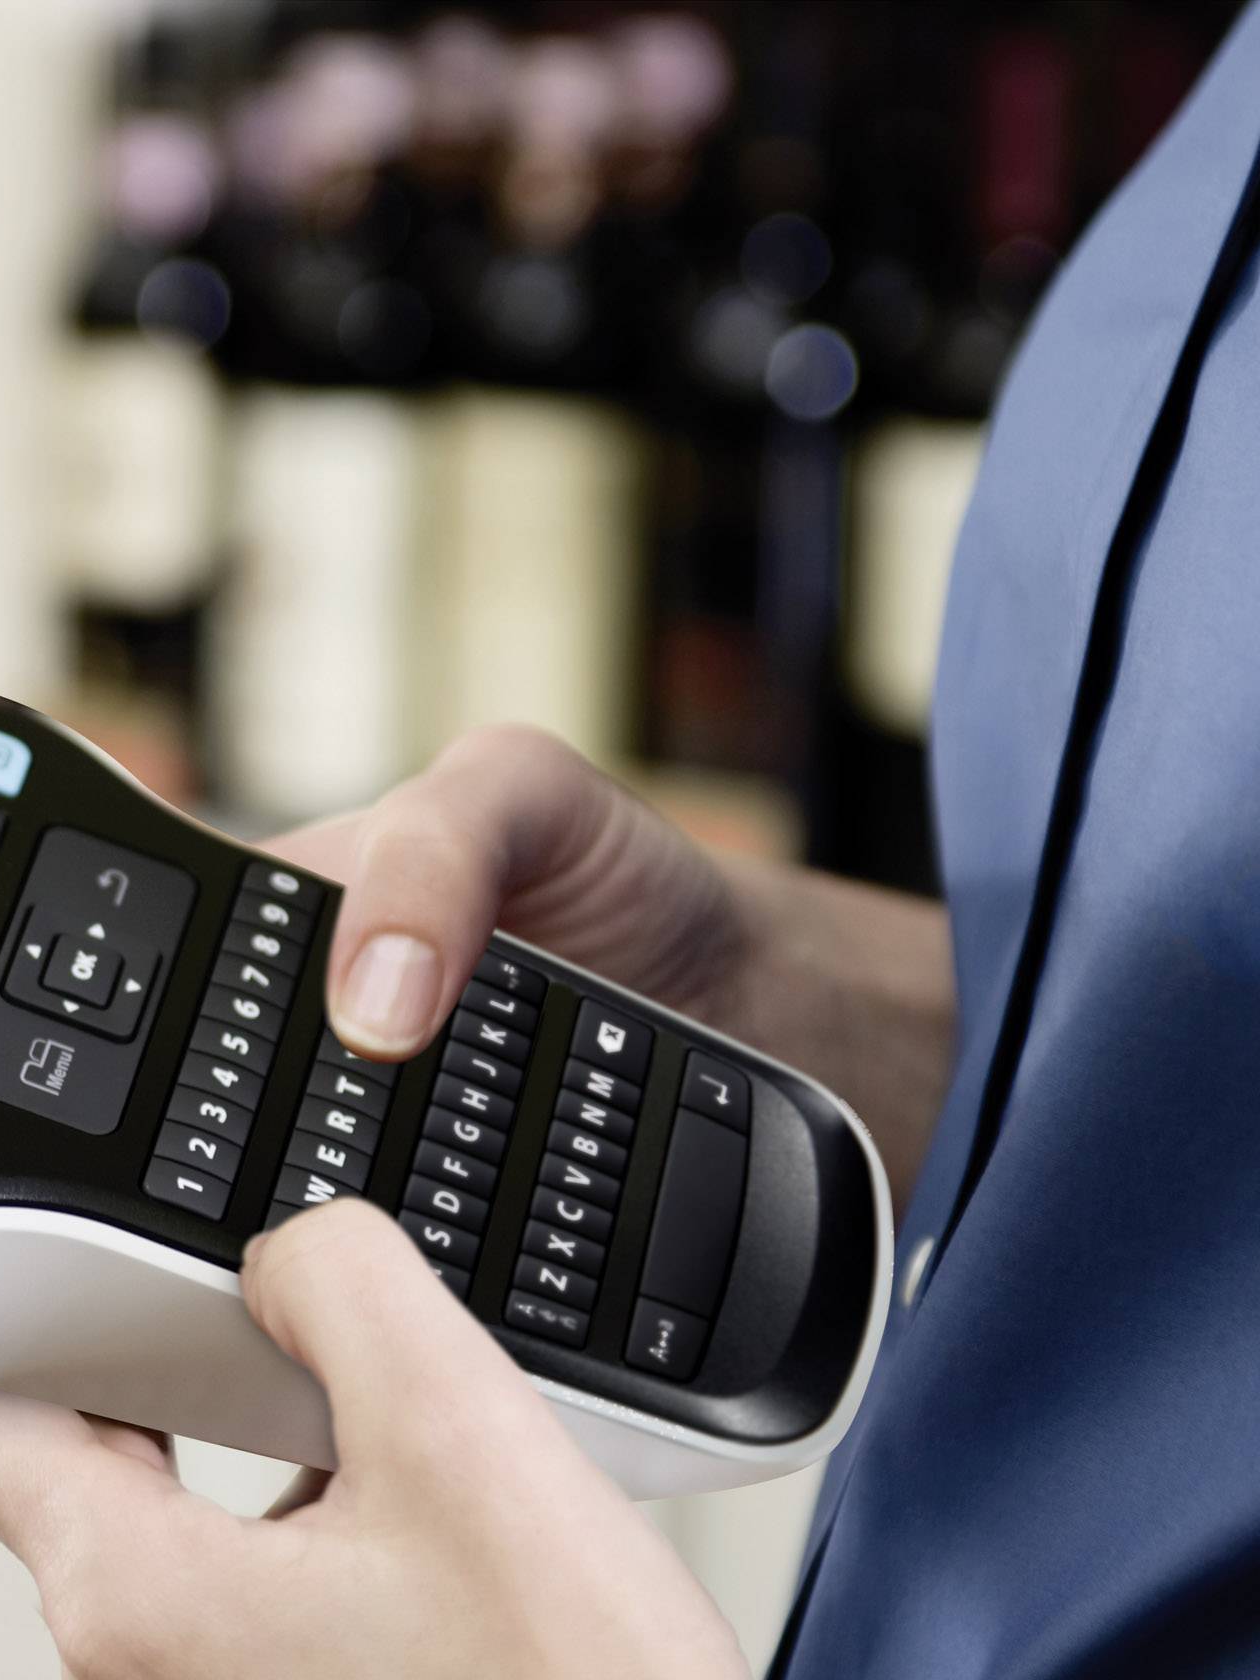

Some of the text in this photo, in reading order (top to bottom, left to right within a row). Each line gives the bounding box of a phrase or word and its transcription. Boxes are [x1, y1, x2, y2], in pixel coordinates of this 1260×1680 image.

[269, 871, 300, 894] 0
[260, 903, 289, 926] 9
[251, 934, 281, 956] 8
[71, 950, 98, 981] OK
[241, 965, 270, 987] 7
[232, 998, 261, 1019] 6
[489, 998, 516, 1013] L
[221, 1032, 250, 1055] 5
[480, 1023, 507, 1045] K
[46, 1050, 73, 1090] Menu
[212, 1067, 239, 1088] 4
[471, 1058, 497, 1077] J
[335, 1075, 365, 1096] T
[587, 1071, 615, 1098] M
[461, 1087, 490, 1111] H
[199, 1102, 228, 1124] 3
[326, 1110, 357, 1134] R
[580, 1103, 607, 1126] N
[453, 1120, 481, 1142] G
[188, 1137, 217, 1160] 2
[316, 1144, 346, 1168] E
[572, 1135, 599, 1157] B
[443, 1156, 469, 1177] F
[564, 1165, 591, 1186] V
[176, 1176, 204, 1193] 1
[303, 1175, 337, 1203] W
[432, 1190, 460, 1214] D
[556, 1200, 584, 1222] C
[424, 1226, 451, 1248] S
[547, 1233, 576, 1257] X
[539, 1267, 568, 1292] Z
